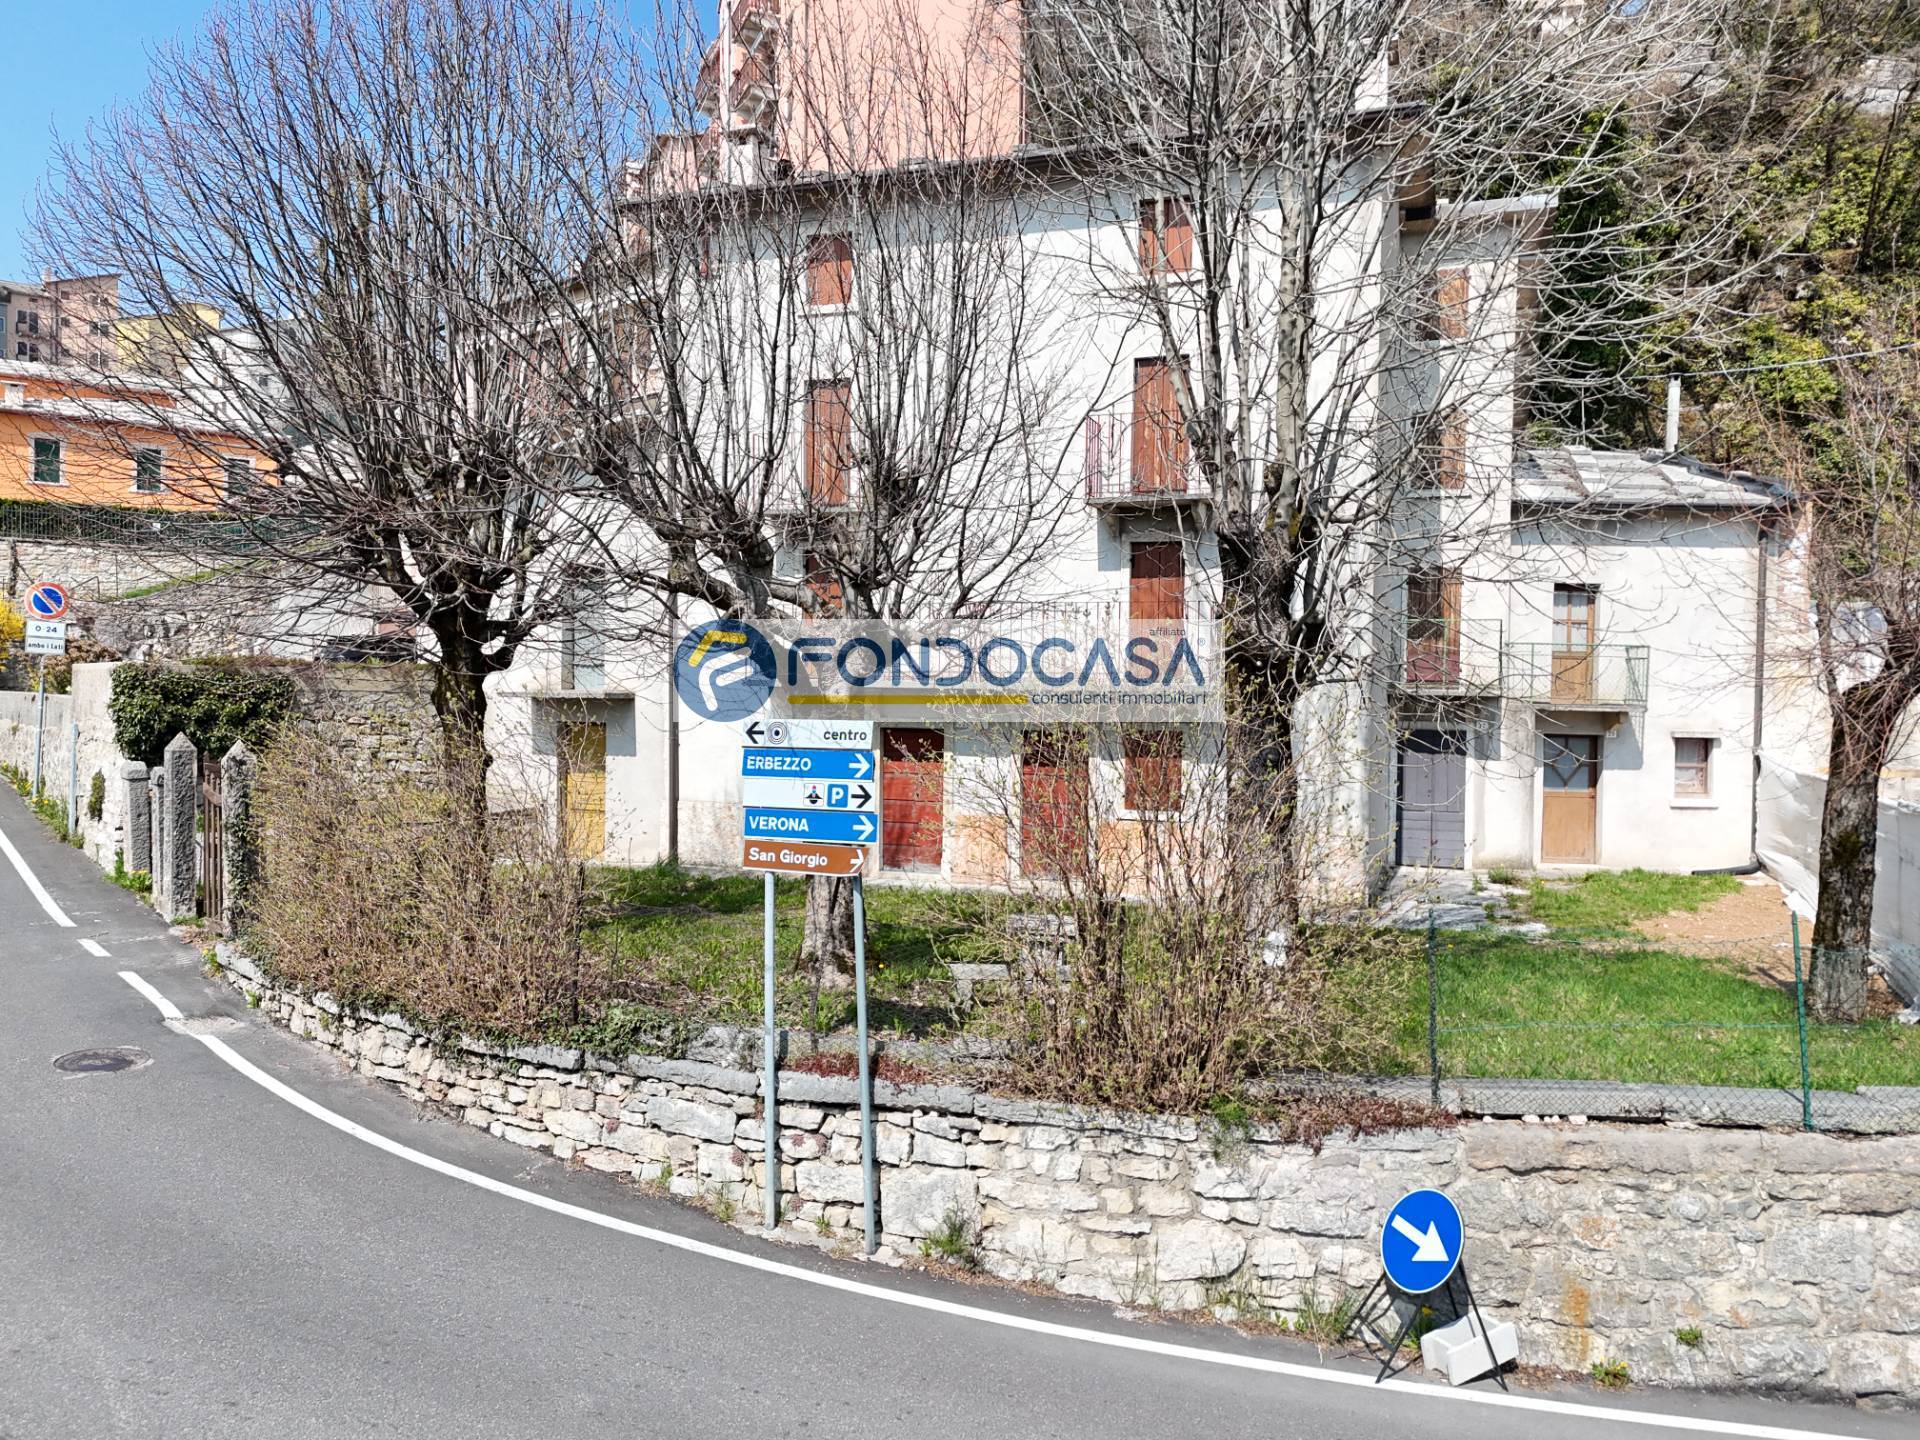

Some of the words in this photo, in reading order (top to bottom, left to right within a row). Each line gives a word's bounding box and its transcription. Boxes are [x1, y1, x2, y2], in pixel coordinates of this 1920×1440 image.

[823, 729, 868, 741] centro
[746, 756, 812, 771] ERBEZZO
[831, 788, 844, 804] P
[749, 815, 809, 832] VERONA
[748, 847, 776, 862] San
[780, 849, 828, 867] Giorgio
